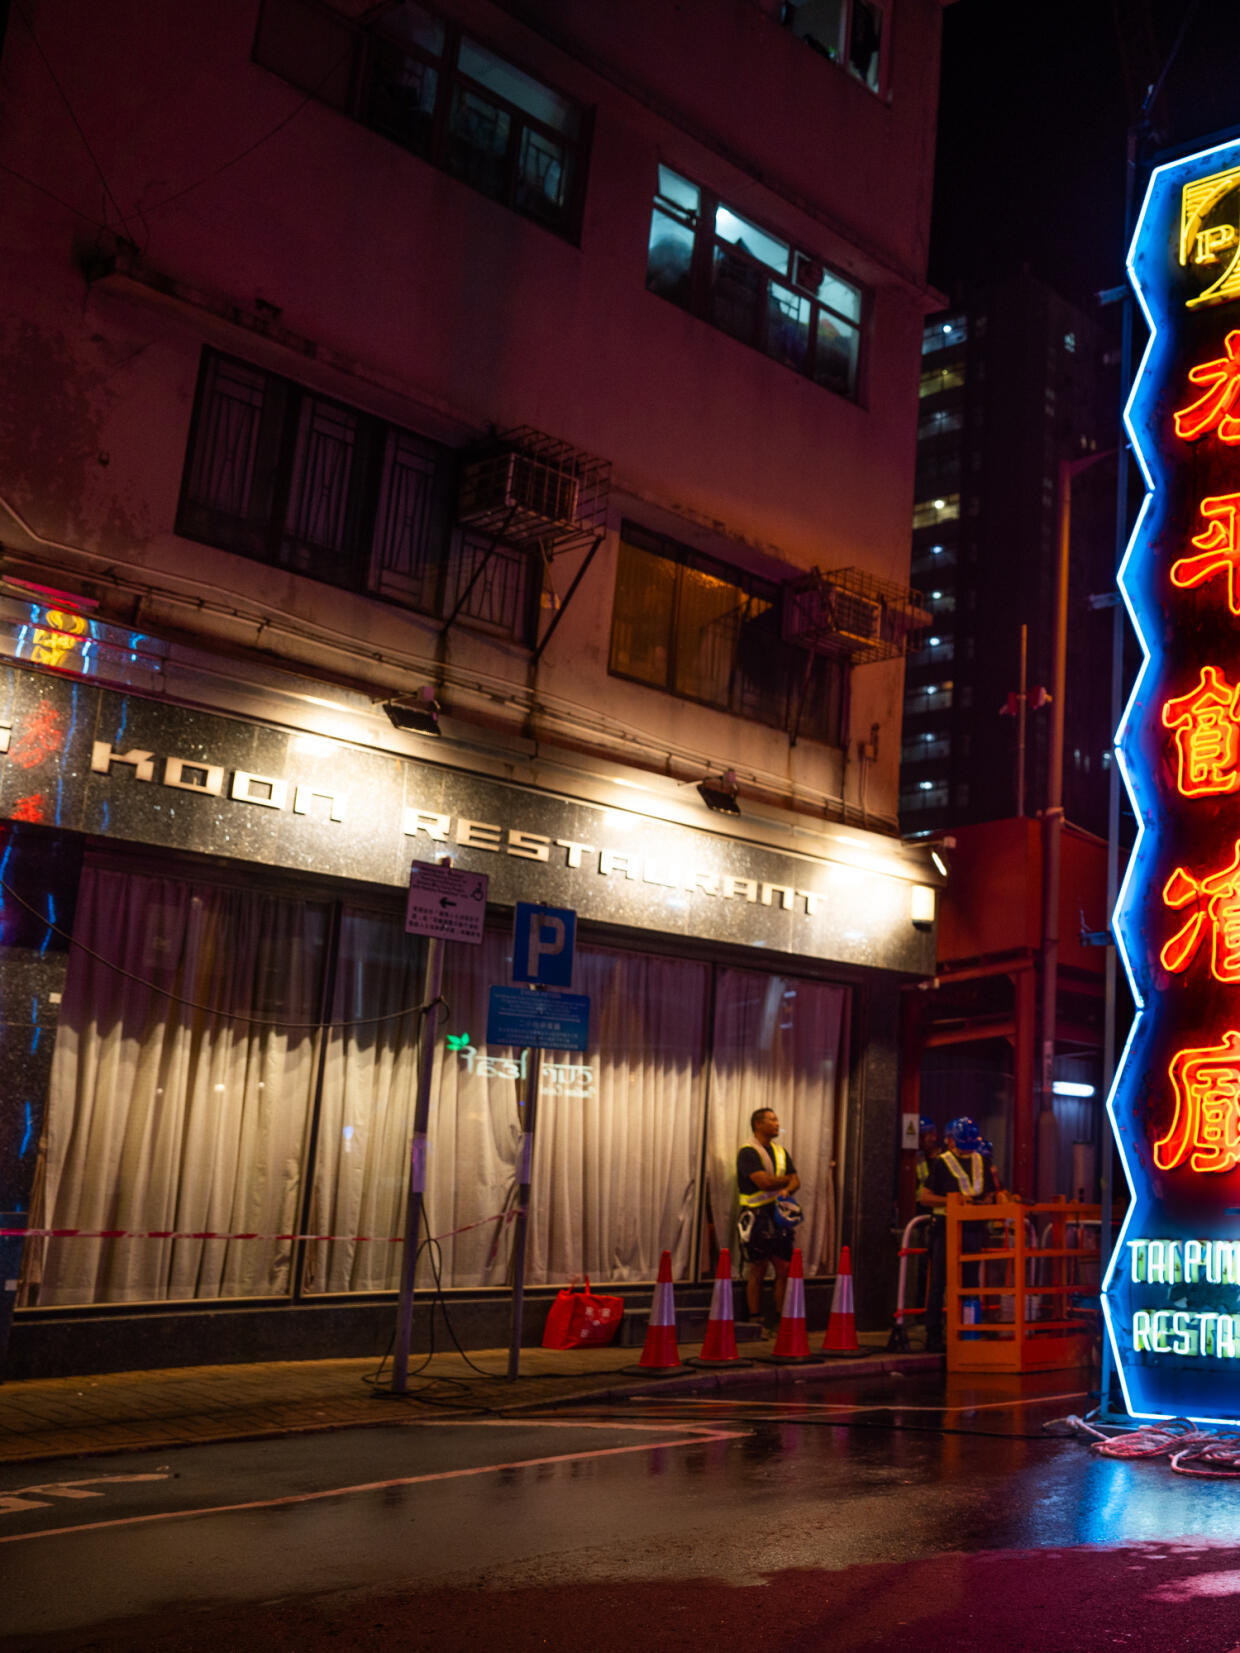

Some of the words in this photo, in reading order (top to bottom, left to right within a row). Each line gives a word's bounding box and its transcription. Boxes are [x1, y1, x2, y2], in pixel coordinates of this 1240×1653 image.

[90, 741, 348, 823] KOON
[403, 807, 828, 916] RESTAURANT
[527, 913, 565, 977] P
